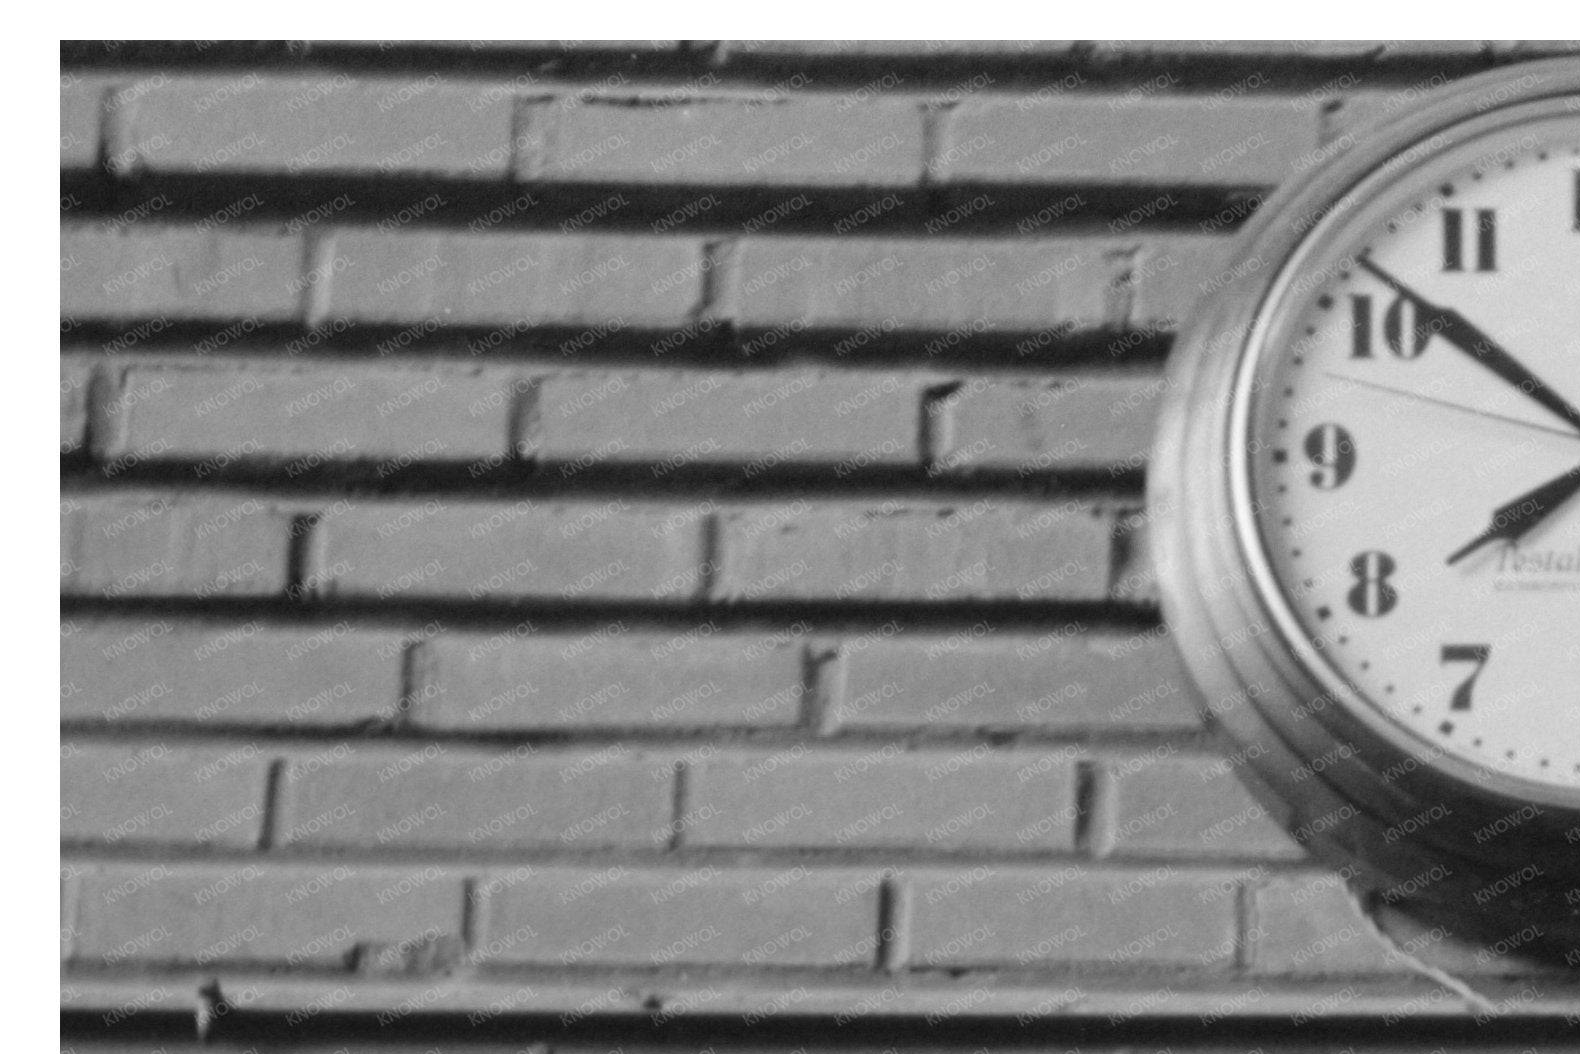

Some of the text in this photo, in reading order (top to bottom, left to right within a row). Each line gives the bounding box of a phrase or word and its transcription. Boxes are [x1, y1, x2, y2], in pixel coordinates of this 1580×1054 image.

[1439, 207, 1498, 272] 11
[1348, 293, 1433, 360] 10
[1303, 423, 1356, 490] 9
[1345, 552, 1398, 618] 8
[1441, 644, 1491, 711] 7
